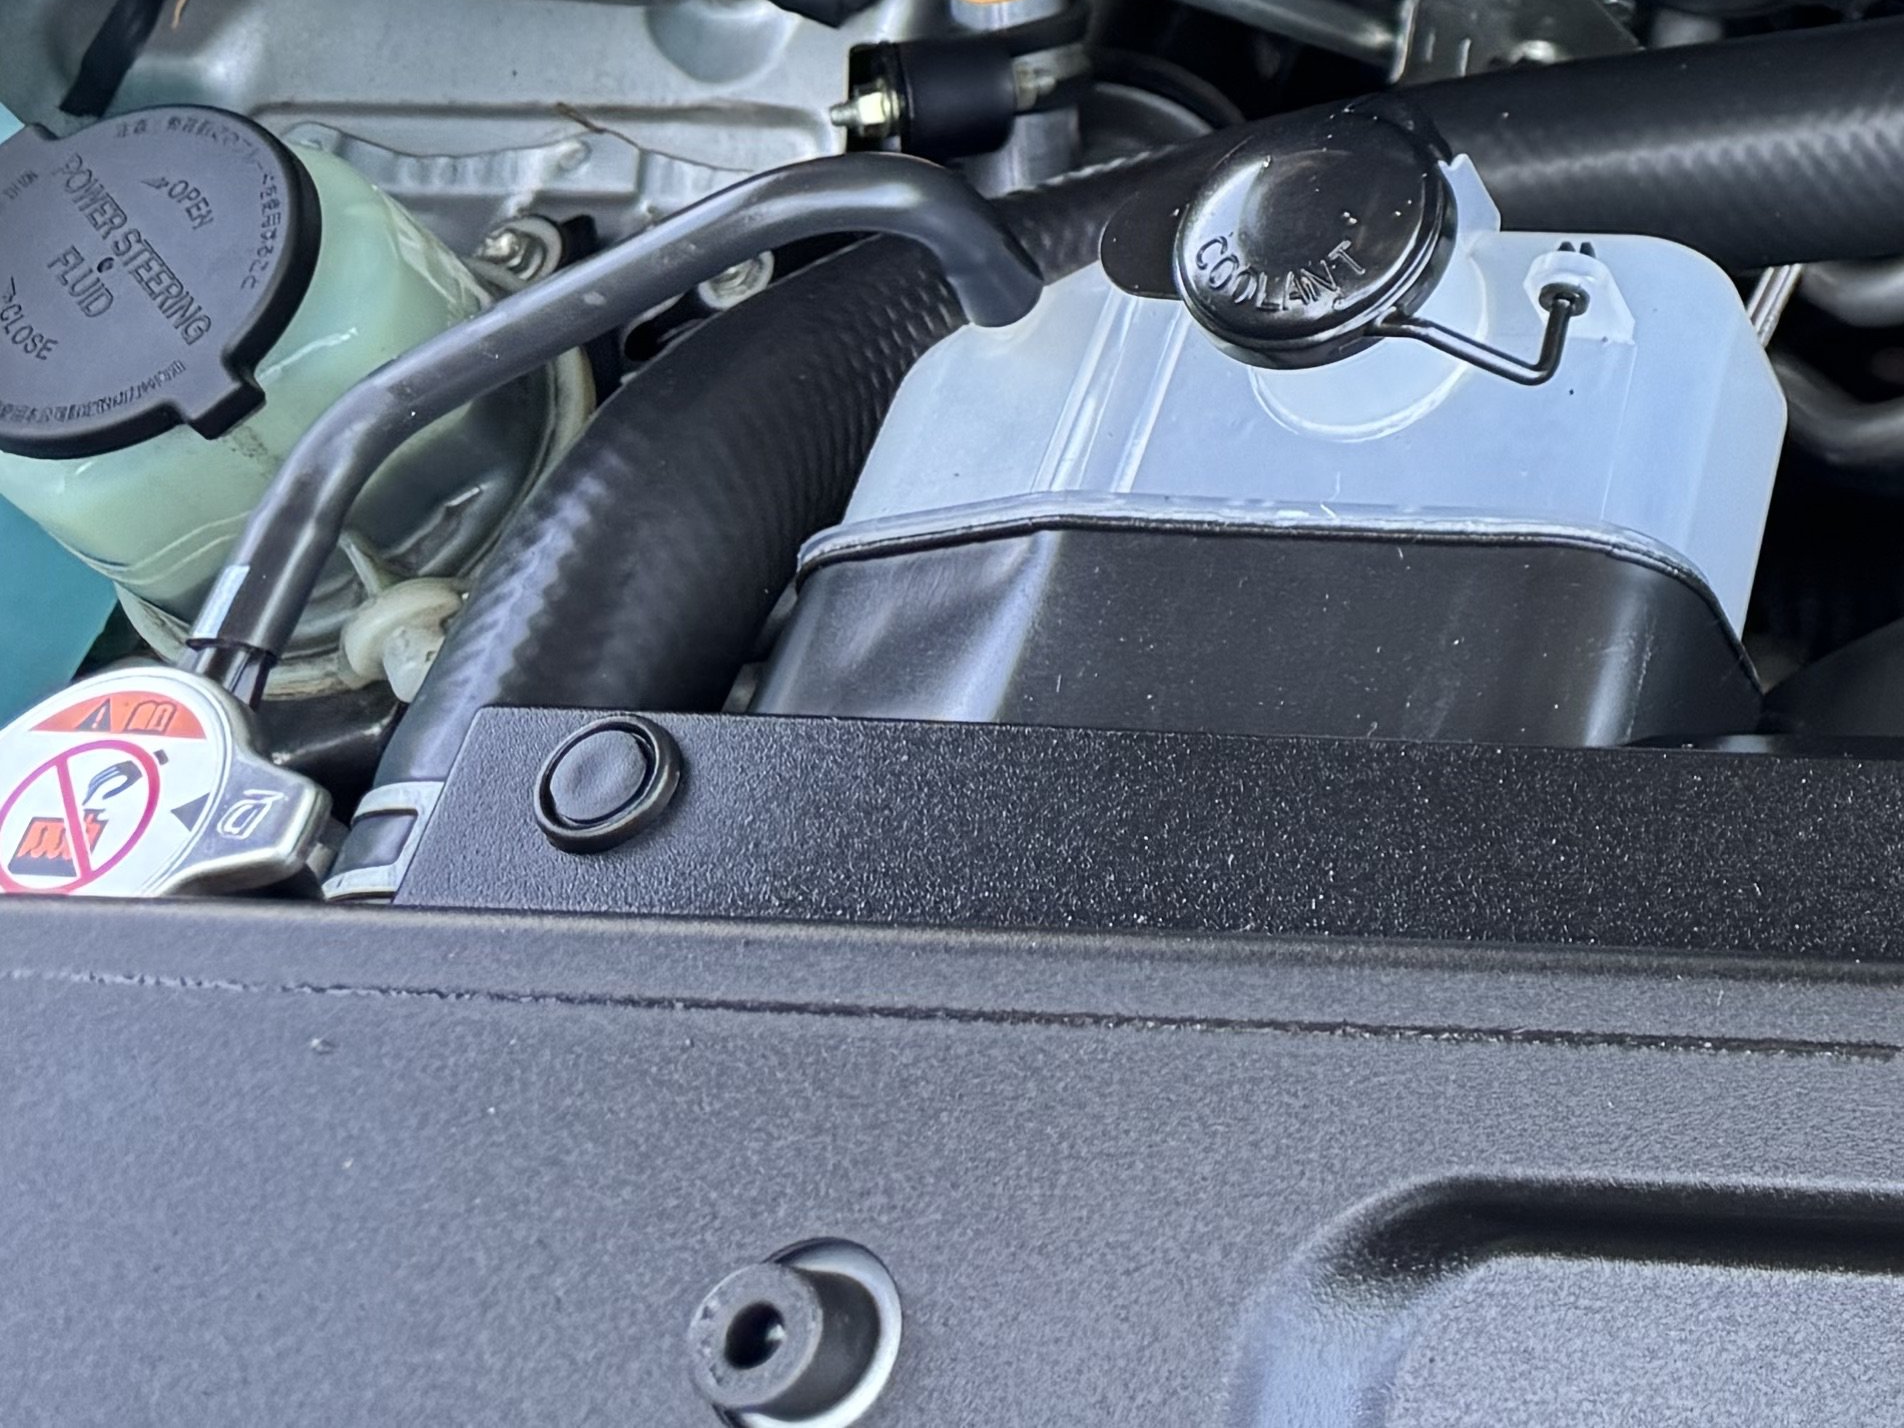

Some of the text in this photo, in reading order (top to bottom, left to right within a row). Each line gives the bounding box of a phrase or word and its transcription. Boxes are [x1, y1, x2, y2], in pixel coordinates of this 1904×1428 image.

[167, 178, 215, 231] OPEN
[46, 244, 115, 319] FLUID
[51, 152, 213, 347] POWER STEERING
[1195, 234, 1367, 311] COOLANT
[0, 301, 59, 362] CLOSE
